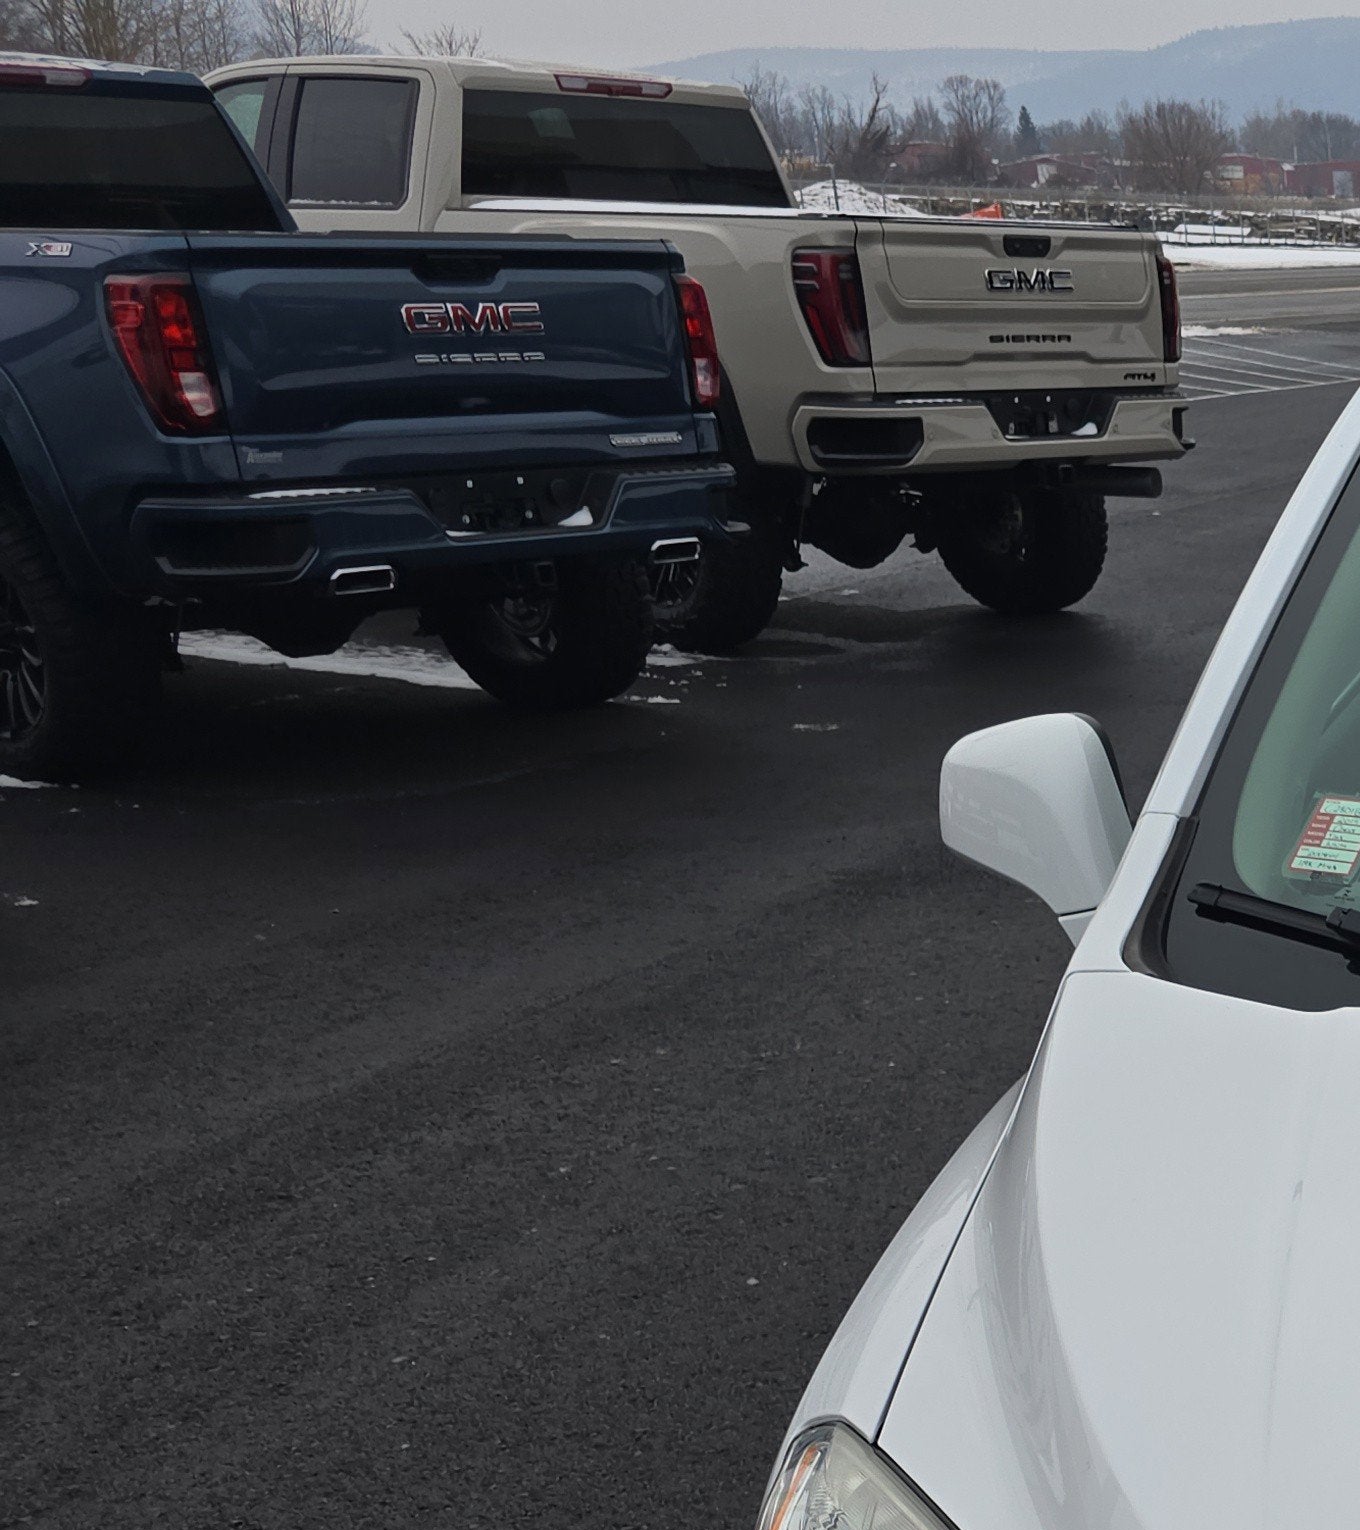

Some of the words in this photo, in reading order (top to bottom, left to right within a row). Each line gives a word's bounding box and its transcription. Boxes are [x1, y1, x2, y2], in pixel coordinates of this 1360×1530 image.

[985, 268, 1075, 292] GMC
[401, 302, 545, 336] GMC
[989, 334, 1071, 343] SIERRA
